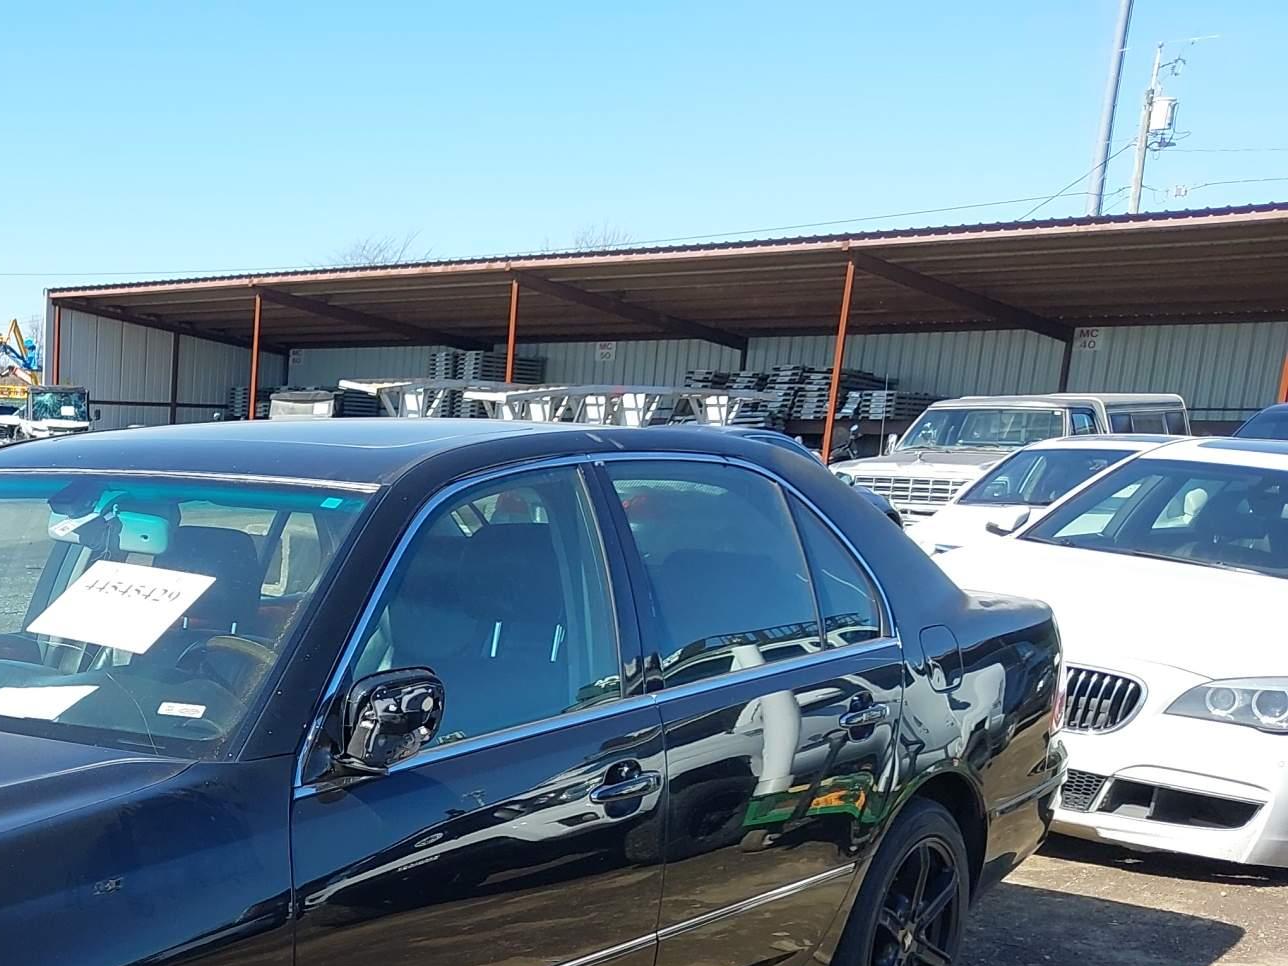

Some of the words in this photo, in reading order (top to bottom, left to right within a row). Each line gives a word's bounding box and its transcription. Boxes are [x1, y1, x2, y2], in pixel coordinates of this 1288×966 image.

[1079, 329, 1099, 338] MC
[1079, 340, 1097, 349] 40
[84, 578, 182, 602] 44545429
